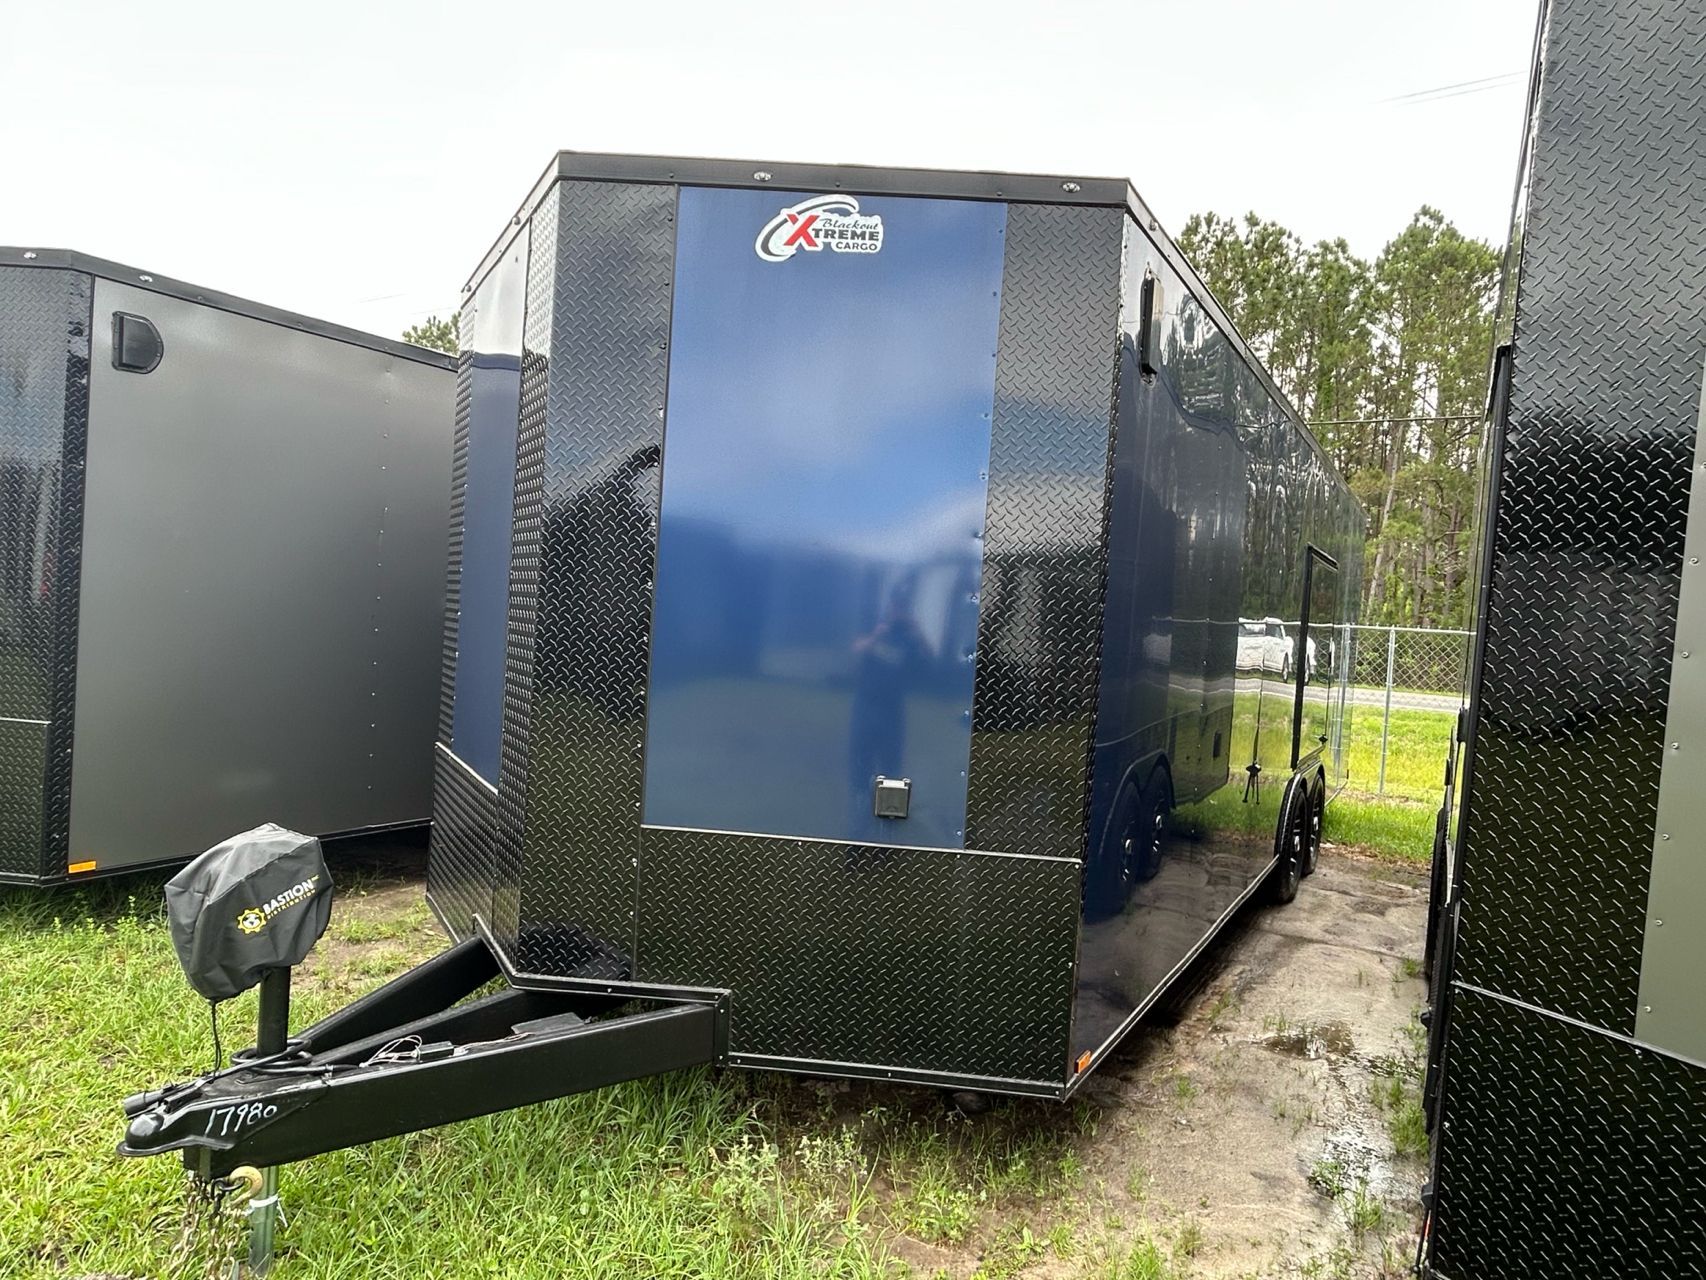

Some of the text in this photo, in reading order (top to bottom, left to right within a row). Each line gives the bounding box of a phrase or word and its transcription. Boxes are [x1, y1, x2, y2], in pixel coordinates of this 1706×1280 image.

[819, 218, 879, 230] Blackout
[835, 241, 878, 251] CARGO
[262, 879, 315, 915] BASTION
[204, 1102, 278, 1137] 17980
